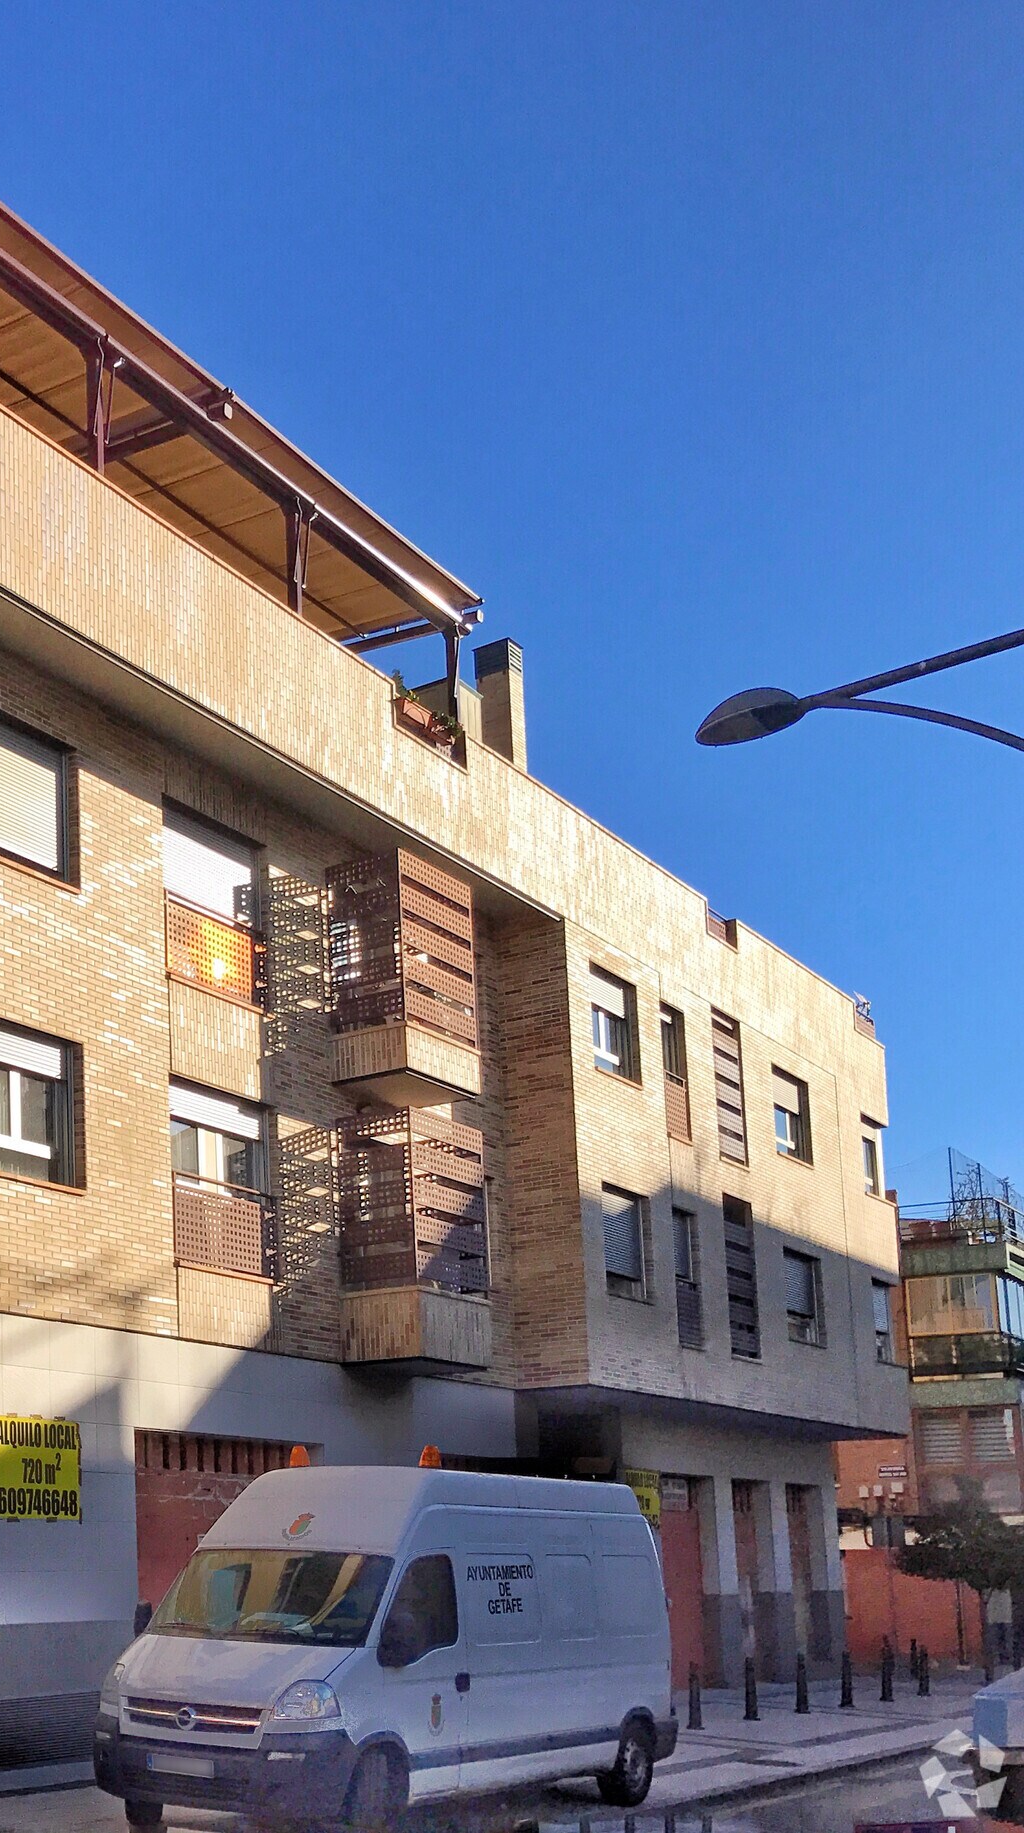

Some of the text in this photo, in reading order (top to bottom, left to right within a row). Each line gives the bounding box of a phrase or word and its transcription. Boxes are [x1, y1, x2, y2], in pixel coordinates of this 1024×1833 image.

[44, 1423, 77, 1450] LOCAL
[22, 1458, 42, 1484] 720
[466, 1565, 534, 1581] AYUNTAMIENTO
[498, 1582, 512, 1597] DE
[488, 1598, 523, 1614] GETAFE
